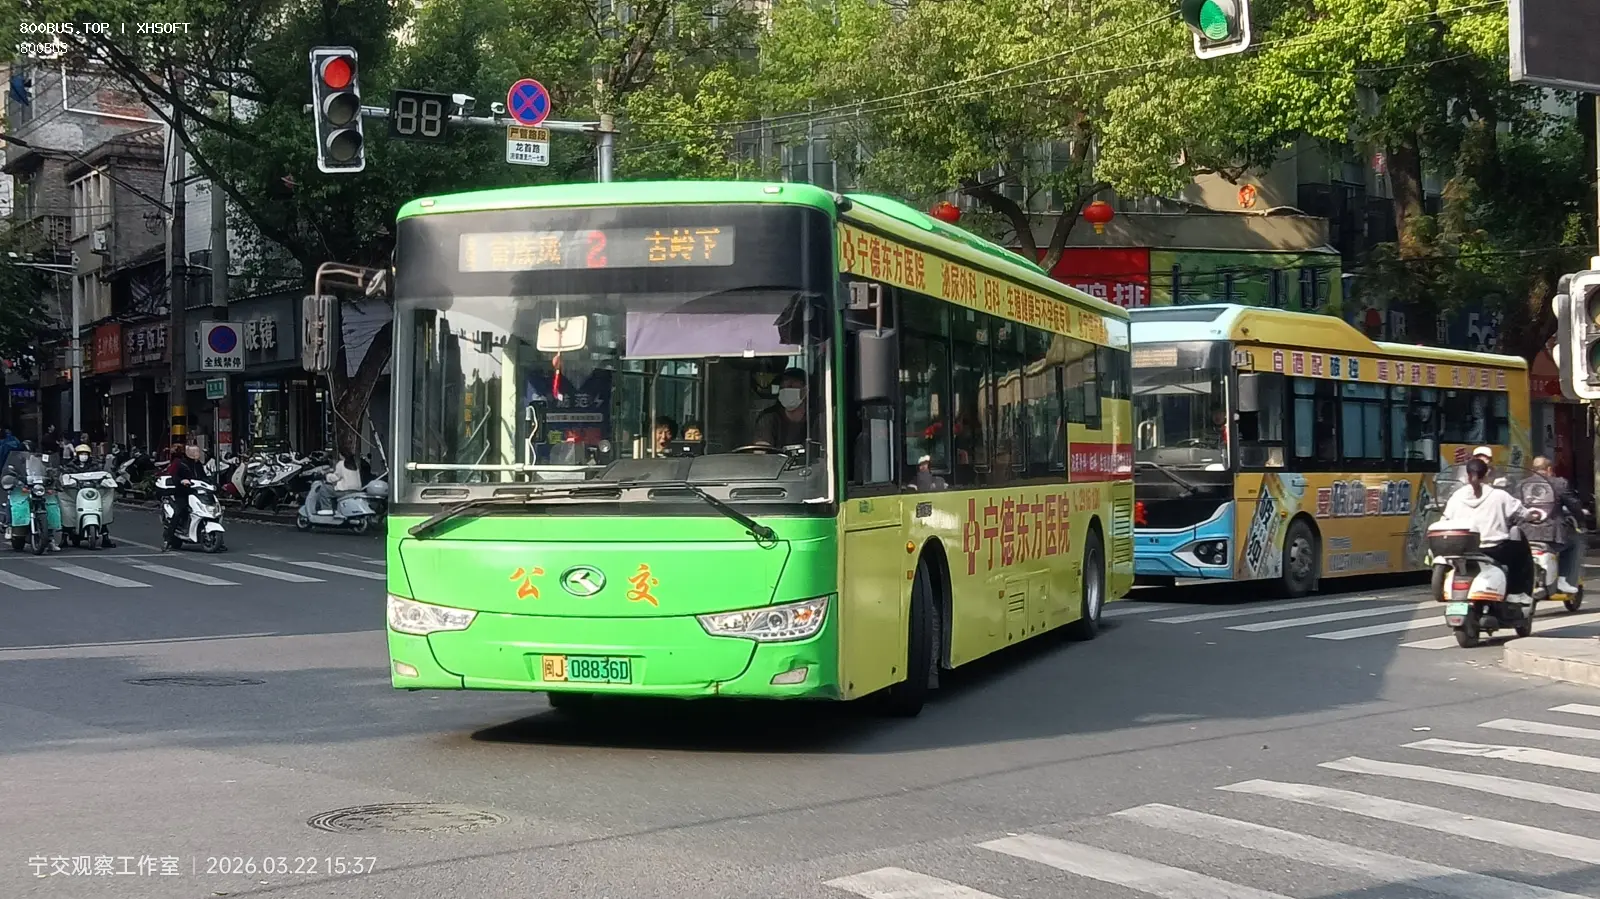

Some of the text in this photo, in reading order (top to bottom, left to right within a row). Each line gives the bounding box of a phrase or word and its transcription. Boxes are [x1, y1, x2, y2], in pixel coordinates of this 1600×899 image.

[515, 142, 540, 153] 龙首路
[586, 231, 607, 268] 2
[857, 233, 926, 290] 宁德东方医院
[204, 356, 242, 368] 全线禁停
[983, 491, 1071, 572] 宁德东方医院
[510, 564, 660, 607] 公 交
